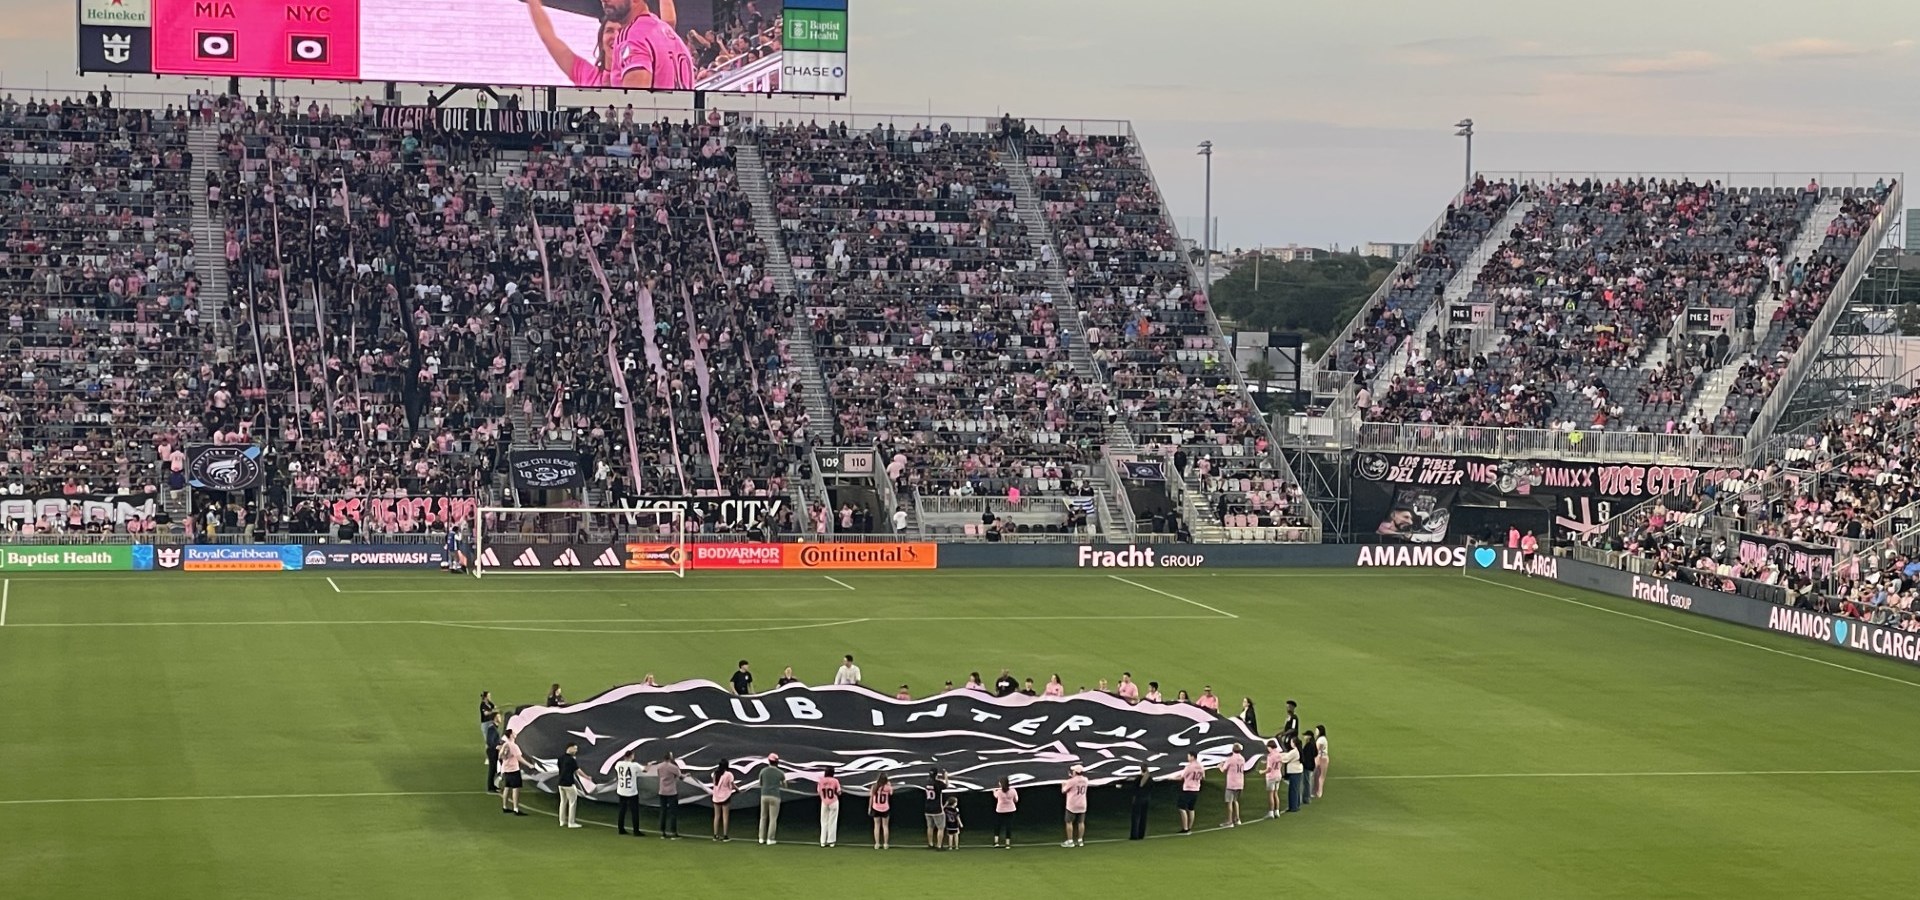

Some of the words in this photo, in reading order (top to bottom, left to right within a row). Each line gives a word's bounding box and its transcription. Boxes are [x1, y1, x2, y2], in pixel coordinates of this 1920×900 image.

[87, 9, 145, 21] Heineken
[195, 2, 235, 19] MIA
[286, 6, 330, 22] NYC
[810, 20, 840, 32] Baptist
[810, 30, 838, 40] Health
[203, 36, 230, 56] 0
[296, 40, 323, 59] 0
[784, 66, 829, 77] CHASE
[443, 108, 469, 132] QUE
[475, 108, 493, 131] LA
[498, 110, 524, 133] MLS
[822, 458, 840, 467] 109
[852, 458, 866, 467] 110
[1399, 456, 1420, 469] LOS
[1422, 457, 1456, 471] PIBES
[1386, 466, 1413, 483] DEL
[1418, 469, 1464, 485] INTER
[1598, 465, 1645, 496] VICE
[1646, 466, 1699, 497] CITY
[721, 499, 782, 527] CITY
[1895, 523, 1909, 532] 113
[8, 553, 60, 566] Baptist
[64, 552, 112, 564] Health
[188, 549, 279, 561] RoyalCaribbean
[351, 553, 427, 564] POWERWASH
[698, 548, 780, 559] BODYARMOR
[801, 546, 901, 566] Continental
[1078, 545, 1154, 567] Fracht
[1161, 555, 1204, 567] GROUP
[1357, 546, 1466, 567] AMAMOS
[1503, 550, 1523, 570] LA
[1525, 555, 1558, 579] ARGA
[1632, 576, 1669, 605] Fracht
[1670, 594, 1692, 610] GROUP
[1769, 606, 1831, 641] AMAMOS
[1851, 624, 1869, 650] LA
[821, 788, 834, 799] 10
